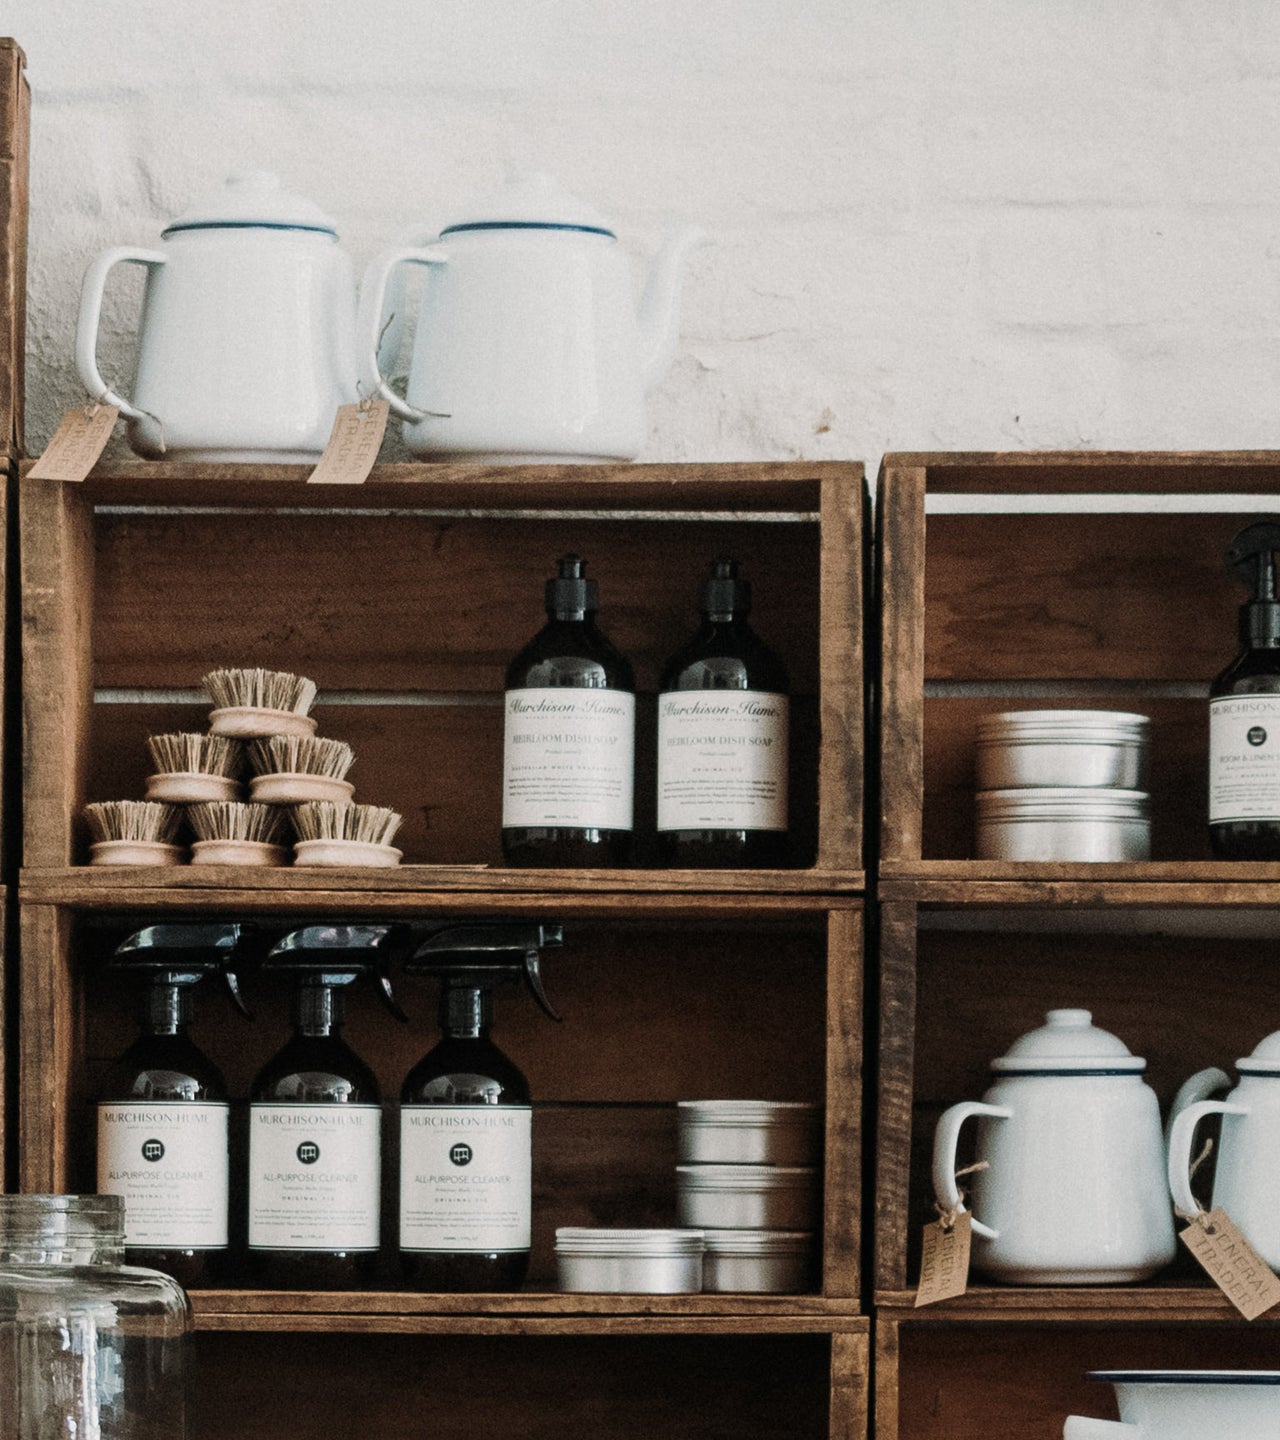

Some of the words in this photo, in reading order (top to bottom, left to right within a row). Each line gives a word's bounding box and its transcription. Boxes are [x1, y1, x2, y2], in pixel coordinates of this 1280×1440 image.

[513, 735, 561, 744] HEIRLOOM
[565, 734, 591, 743] DISH
[668, 737, 716, 747] HEIRLOOM
[719, 737, 746, 746] DISH
[748, 738, 774, 747] SOAP
[164, 1171, 203, 1180] CLEANER
[319, 1174, 358, 1183] CLEANER
[472, 1175, 511, 1184] CLEANER
